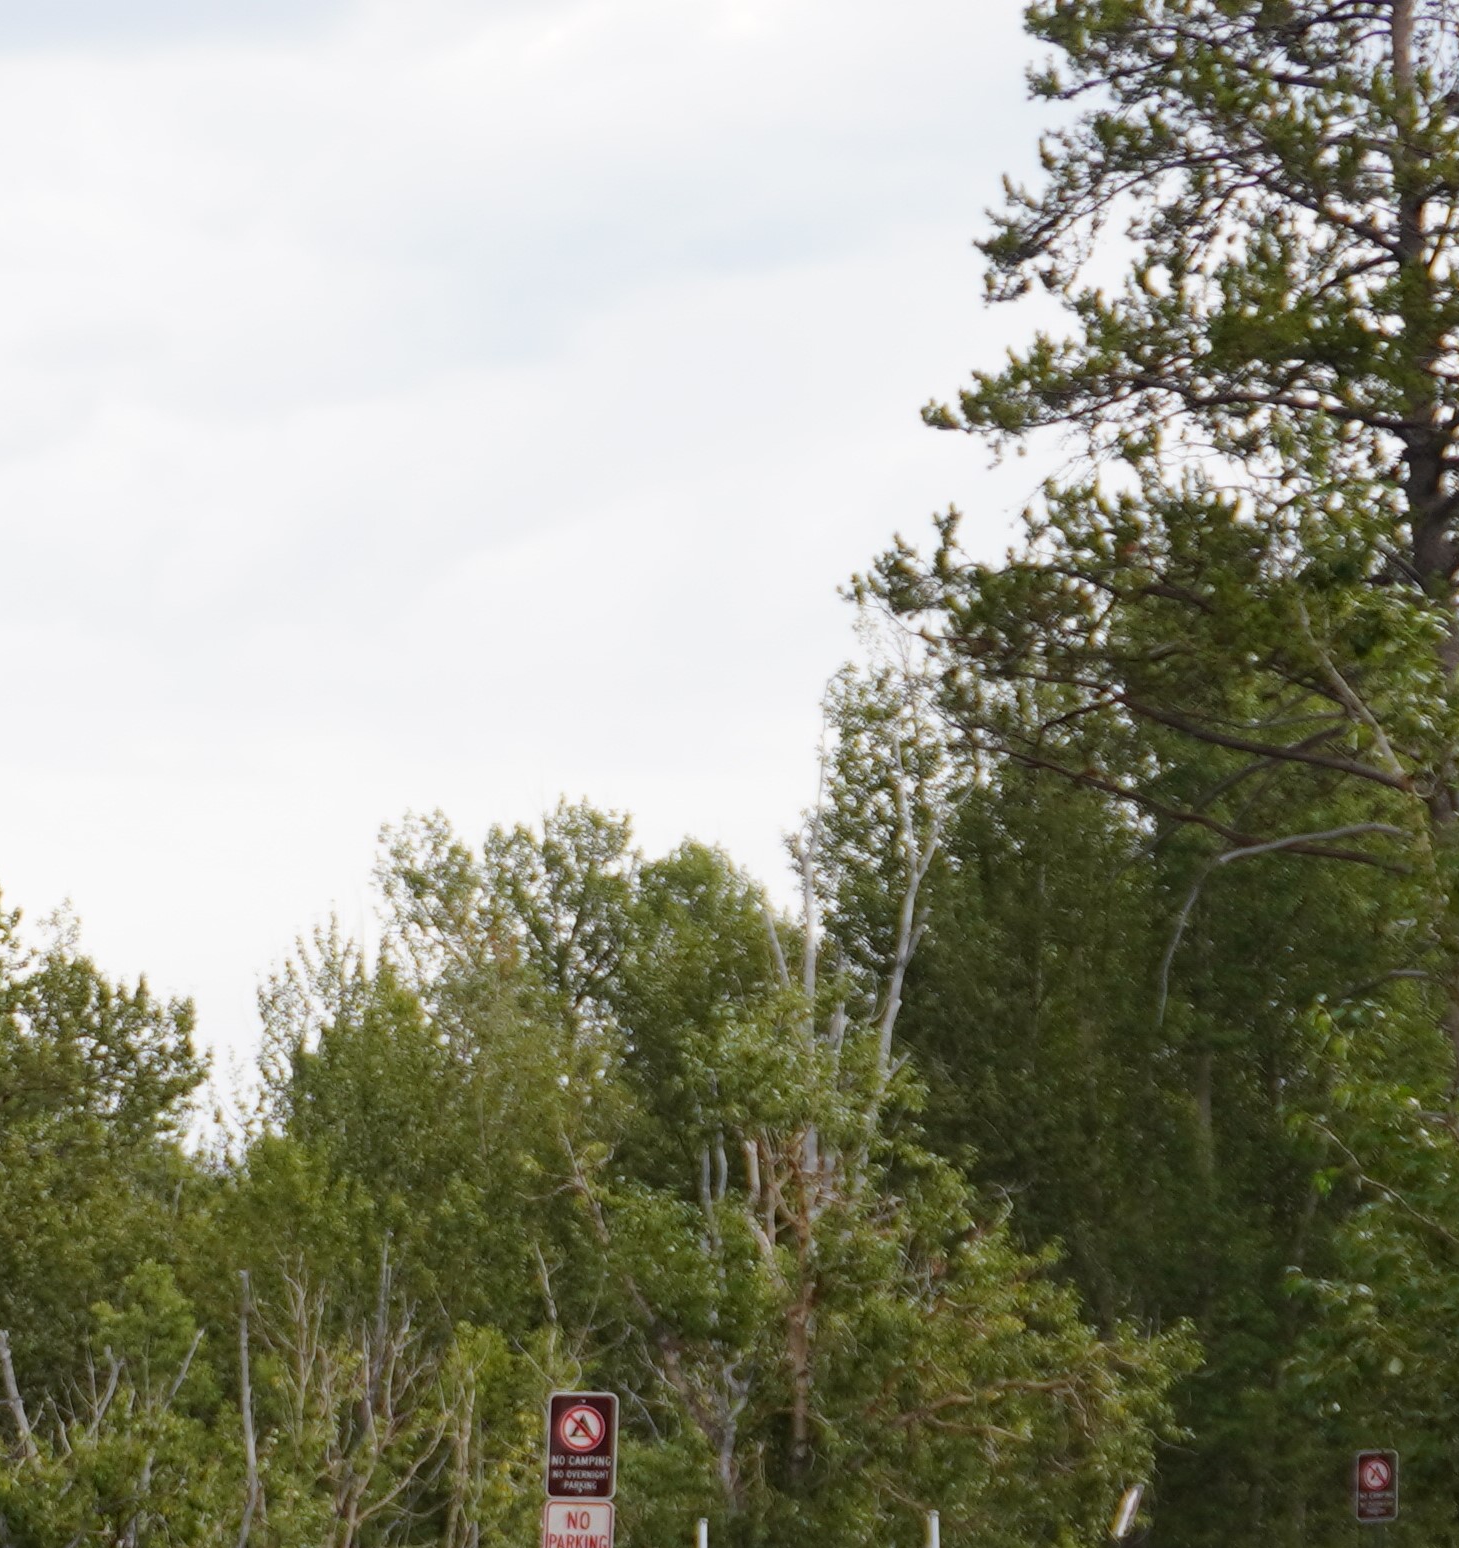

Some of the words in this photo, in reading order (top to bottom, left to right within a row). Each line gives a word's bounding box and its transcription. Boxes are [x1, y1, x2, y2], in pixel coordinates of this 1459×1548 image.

[550, 1455, 565, 1466] NO
[568, 1456, 611, 1466] CAMPING
[552, 1470, 564, 1478] NO
[566, 1470, 609, 1479] OVERNIGHT
[563, 1481, 597, 1490] PARKING
[567, 1511, 590, 1530] NO
